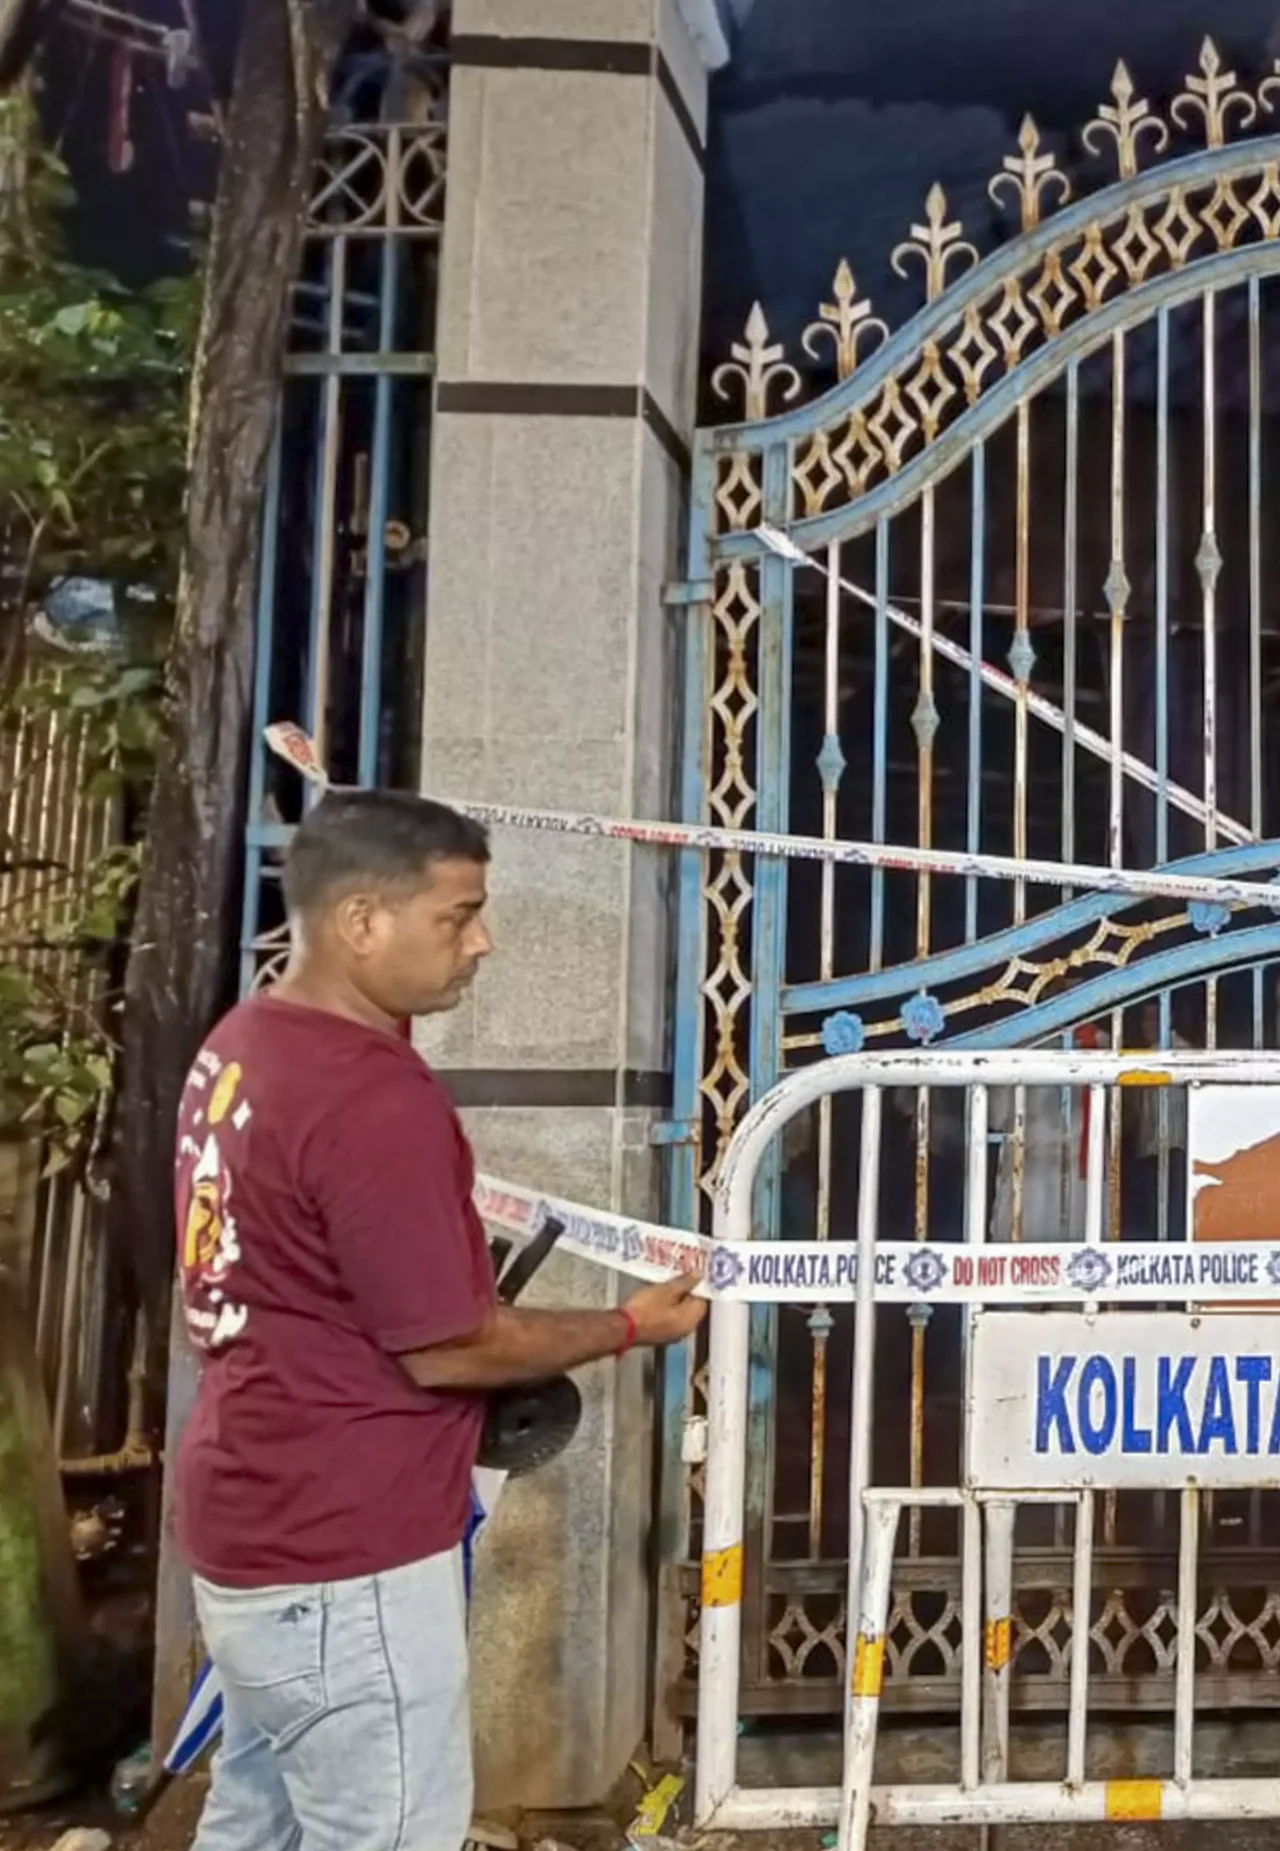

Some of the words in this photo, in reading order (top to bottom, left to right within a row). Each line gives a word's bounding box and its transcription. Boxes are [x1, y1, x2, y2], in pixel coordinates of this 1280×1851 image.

[749, 1254, 830, 1286] KOLKATA
[837, 1254, 897, 1286] POCE
[953, 1256, 973, 1287] DO
[978, 1256, 1007, 1286] NOT
[1010, 1255, 1061, 1286] CROSS
[1116, 1253, 1195, 1286] KOLKATA
[1200, 1253, 1259, 1284] POLICE
